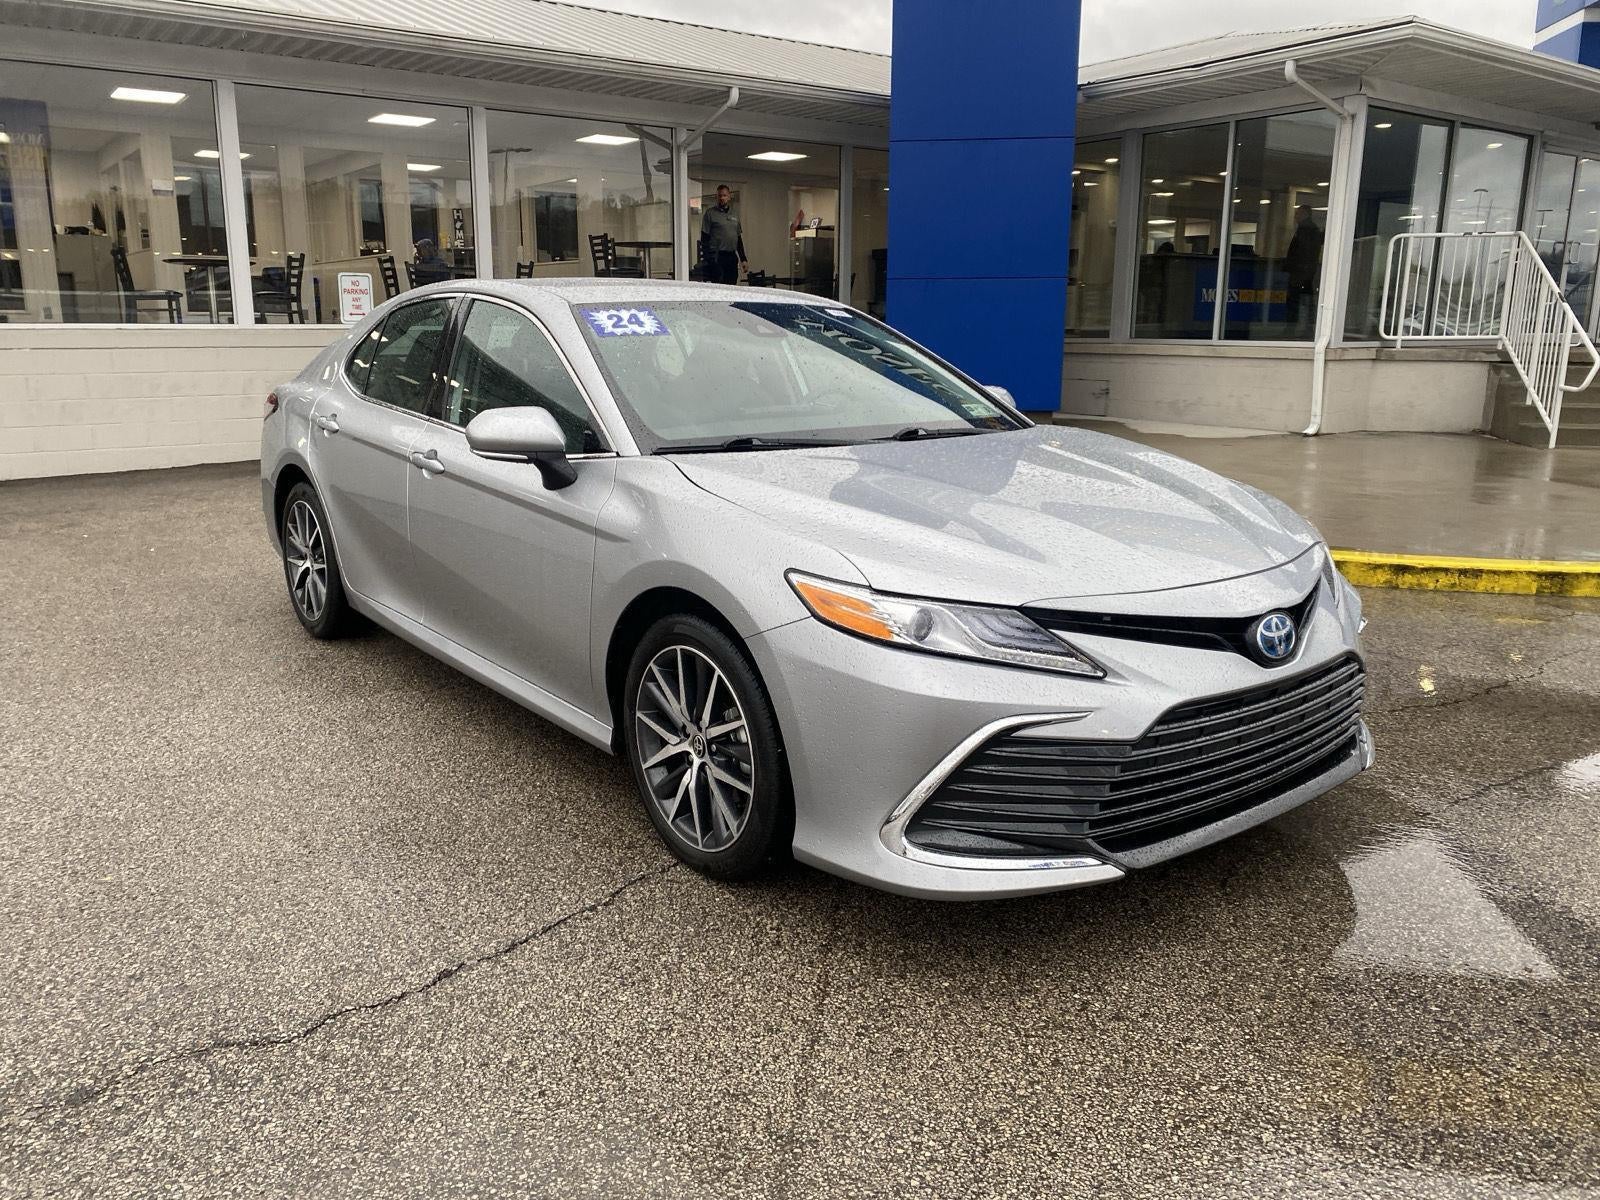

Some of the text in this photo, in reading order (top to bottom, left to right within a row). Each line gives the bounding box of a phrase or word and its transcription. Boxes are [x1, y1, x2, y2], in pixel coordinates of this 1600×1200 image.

[453, 209, 465, 248] HME
[343, 288, 369, 296] PARKING
[1201, 288, 1239, 303] MOES
[607, 313, 645, 329] 24
